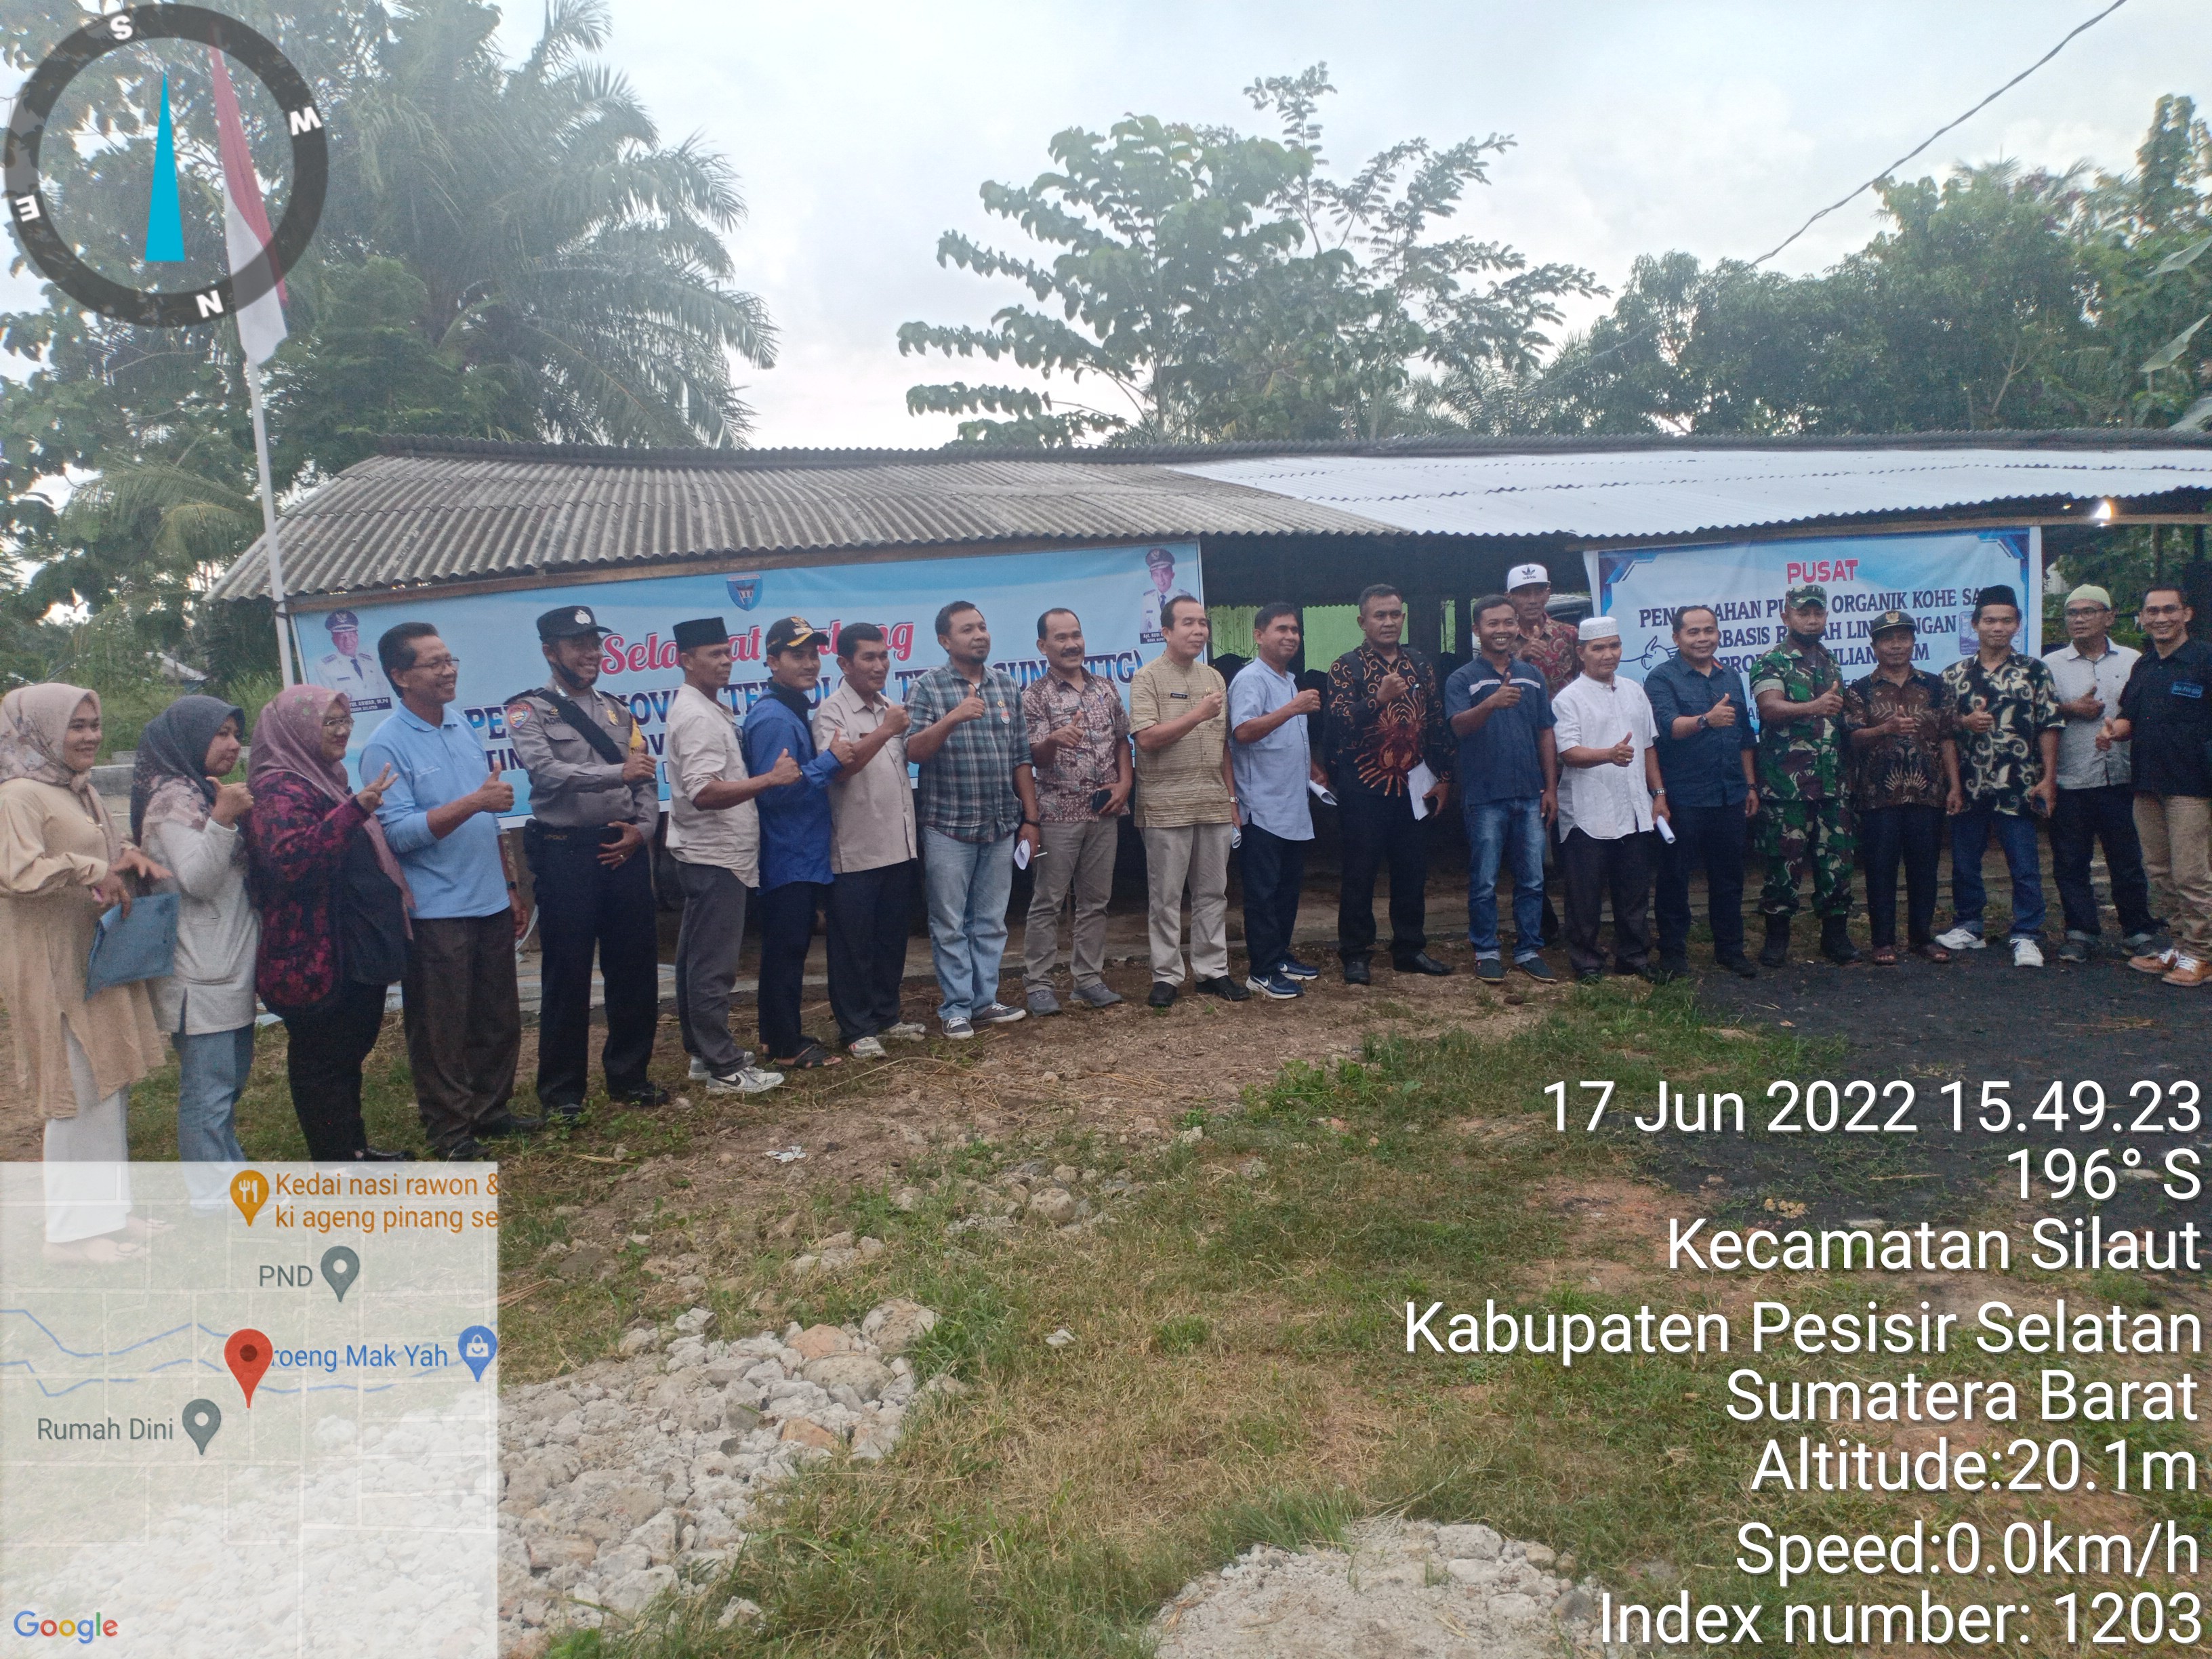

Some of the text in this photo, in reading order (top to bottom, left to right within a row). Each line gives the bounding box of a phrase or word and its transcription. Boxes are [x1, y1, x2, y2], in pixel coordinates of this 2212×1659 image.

[1786, 559, 1858, 583] PUSAT
[1832, 592, 1908, 613] ORGANIK
[1912, 589, 1957, 609] KOHE
